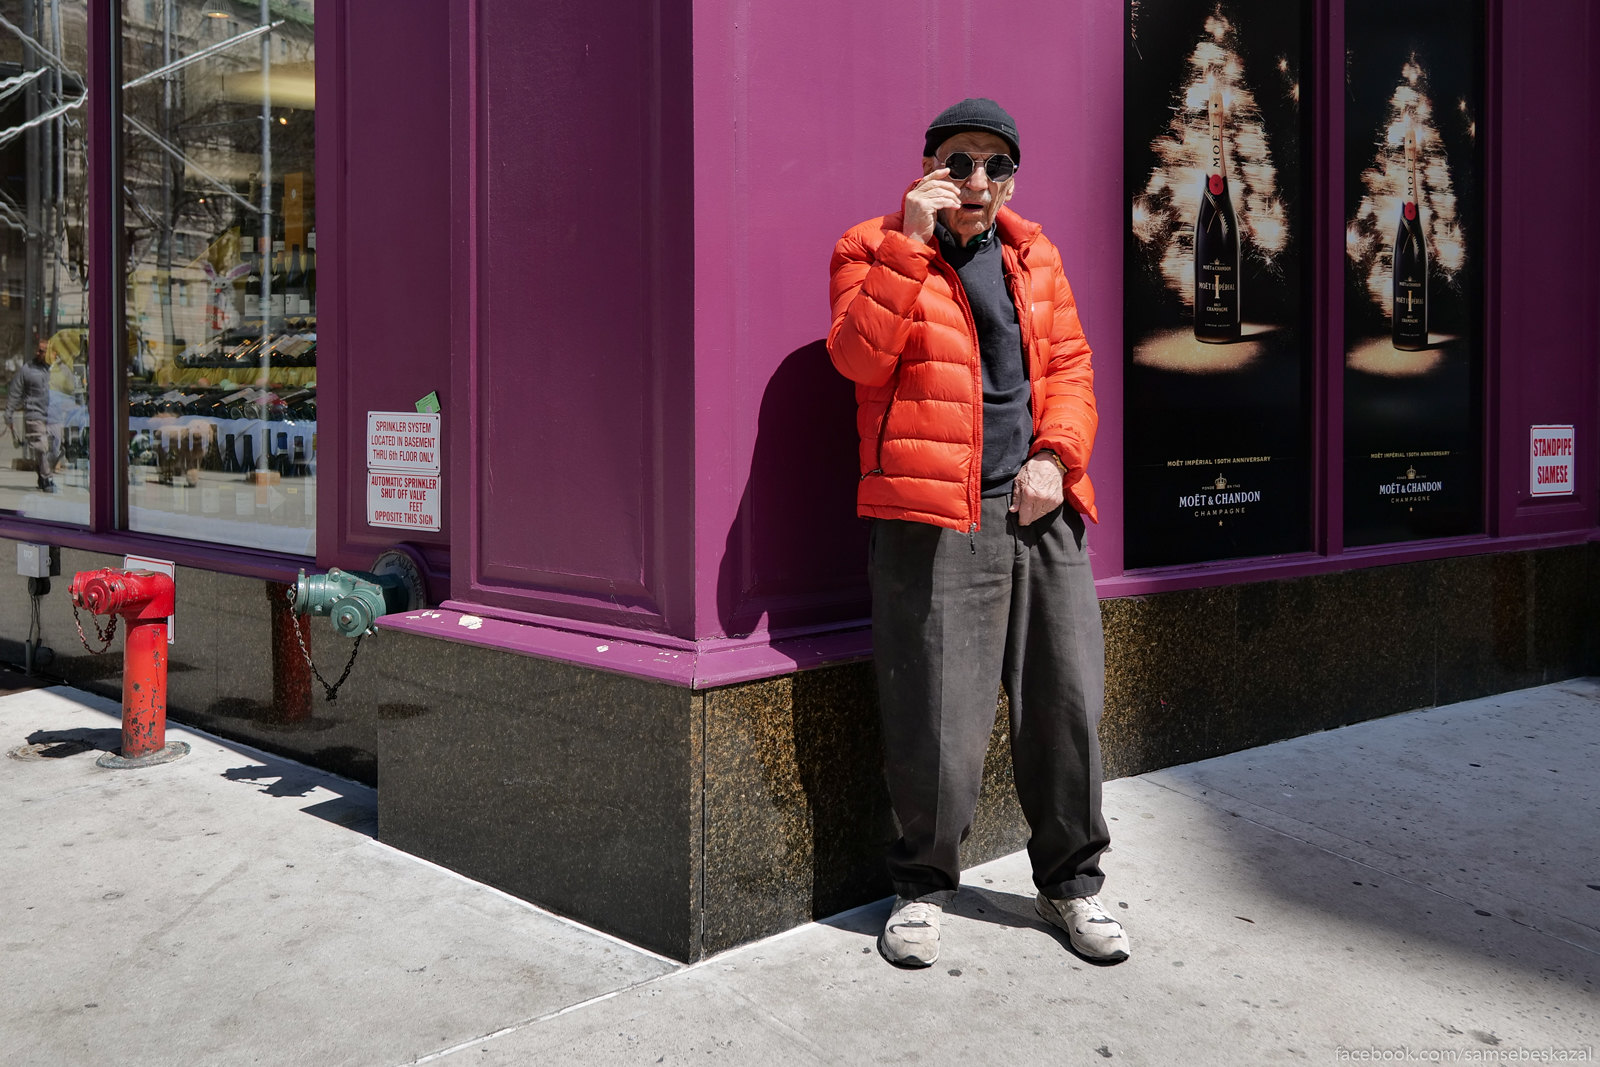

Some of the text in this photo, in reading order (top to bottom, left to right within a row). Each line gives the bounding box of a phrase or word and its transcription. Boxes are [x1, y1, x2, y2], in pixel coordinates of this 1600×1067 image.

[376, 421, 431, 433] SPRINKLER SYSTEM
[371, 435, 435, 449] LOCATED IN BASEMENT
[1534, 438, 1572, 456] STANDPIPE
[373, 449, 434, 463] THRU 6th FLOOR ONLY
[1232, 456, 1271, 464] ANNIVERSARY
[1537, 465, 1568, 484] SIAMESE
[371, 476, 437, 490] AUTOMATIC SPRINKLER
[1401, 485, 1406, 493] &
[1407, 481, 1442, 493] CHANDON
[381, 488, 426, 501] SHUT OFF VALVE
[1179, 491, 1261, 507] MOËT & CHANDON
[409, 502, 423, 512] FEET
[1194, 507, 1245, 517] CHAMPAGNE
[375, 510, 433, 525] OPPOSITE THIS SIGN
